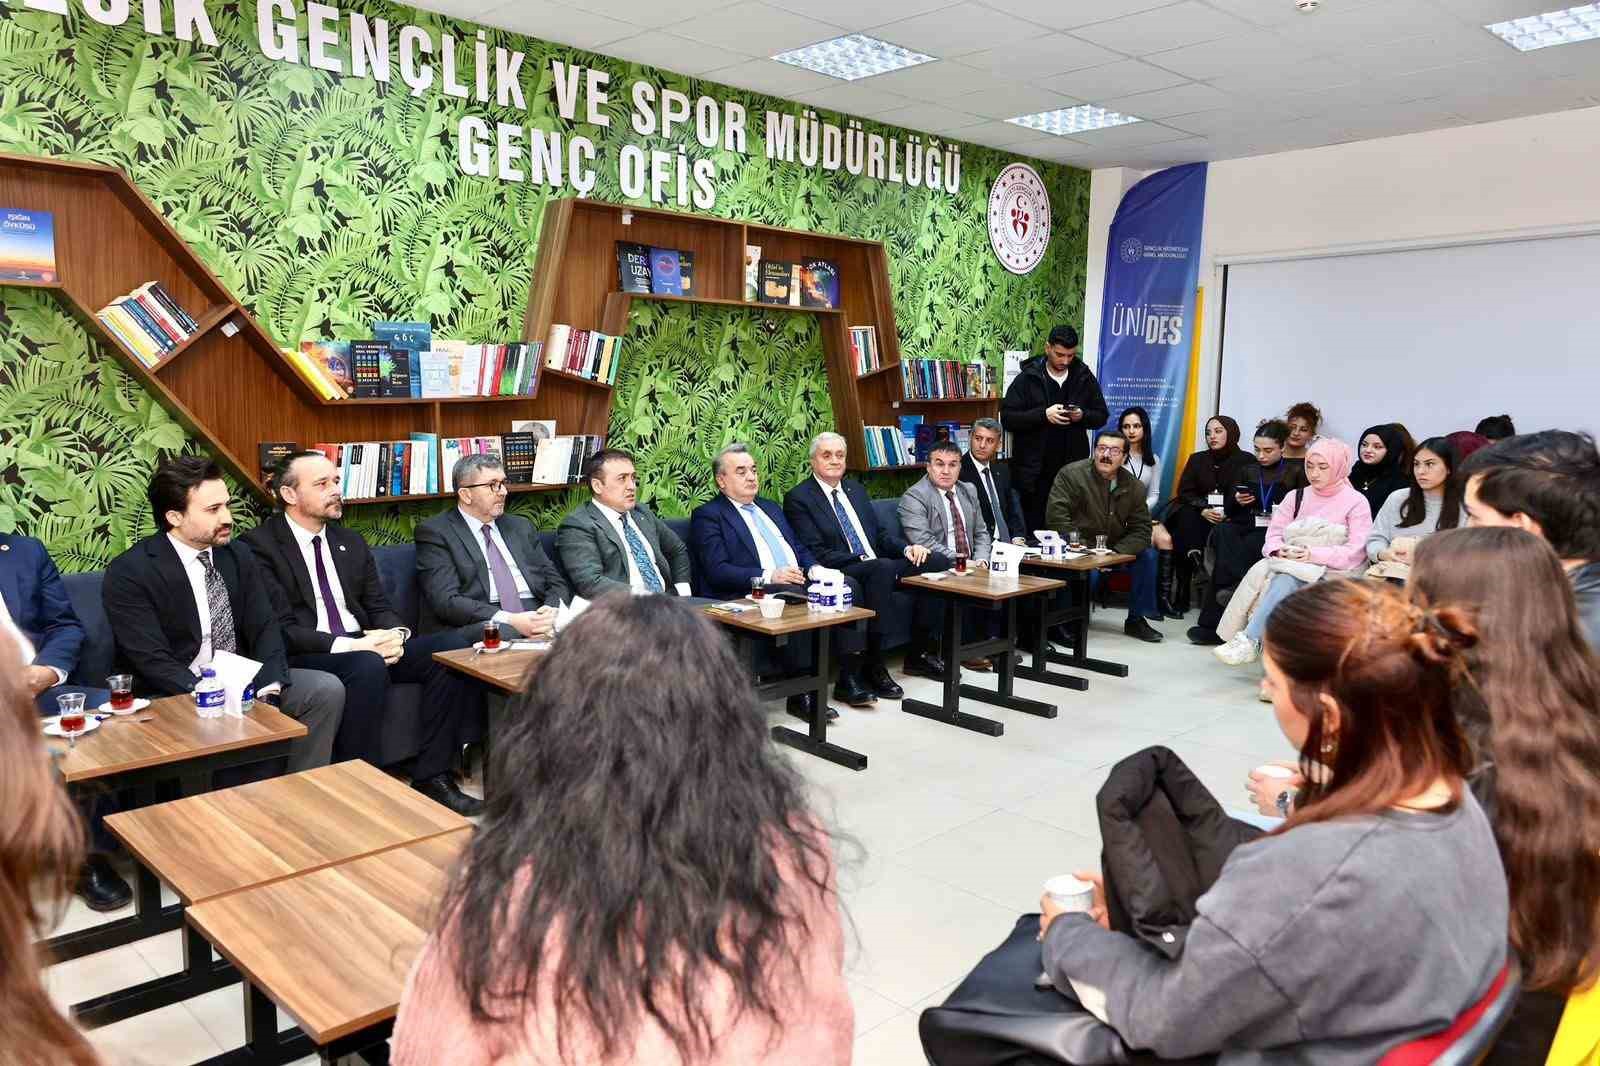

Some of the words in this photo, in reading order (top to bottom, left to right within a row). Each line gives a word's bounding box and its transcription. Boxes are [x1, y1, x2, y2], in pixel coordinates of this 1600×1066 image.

[258, 0, 528, 111] GENÇLİK
[552, 60, 610, 127] VE
[631, 80, 747, 153] SPOR
[765, 109, 961, 194] MÜDÜRLÜĞÜ
[457, 115, 595, 198] GENÇ
[619, 144, 717, 210] OFİS
